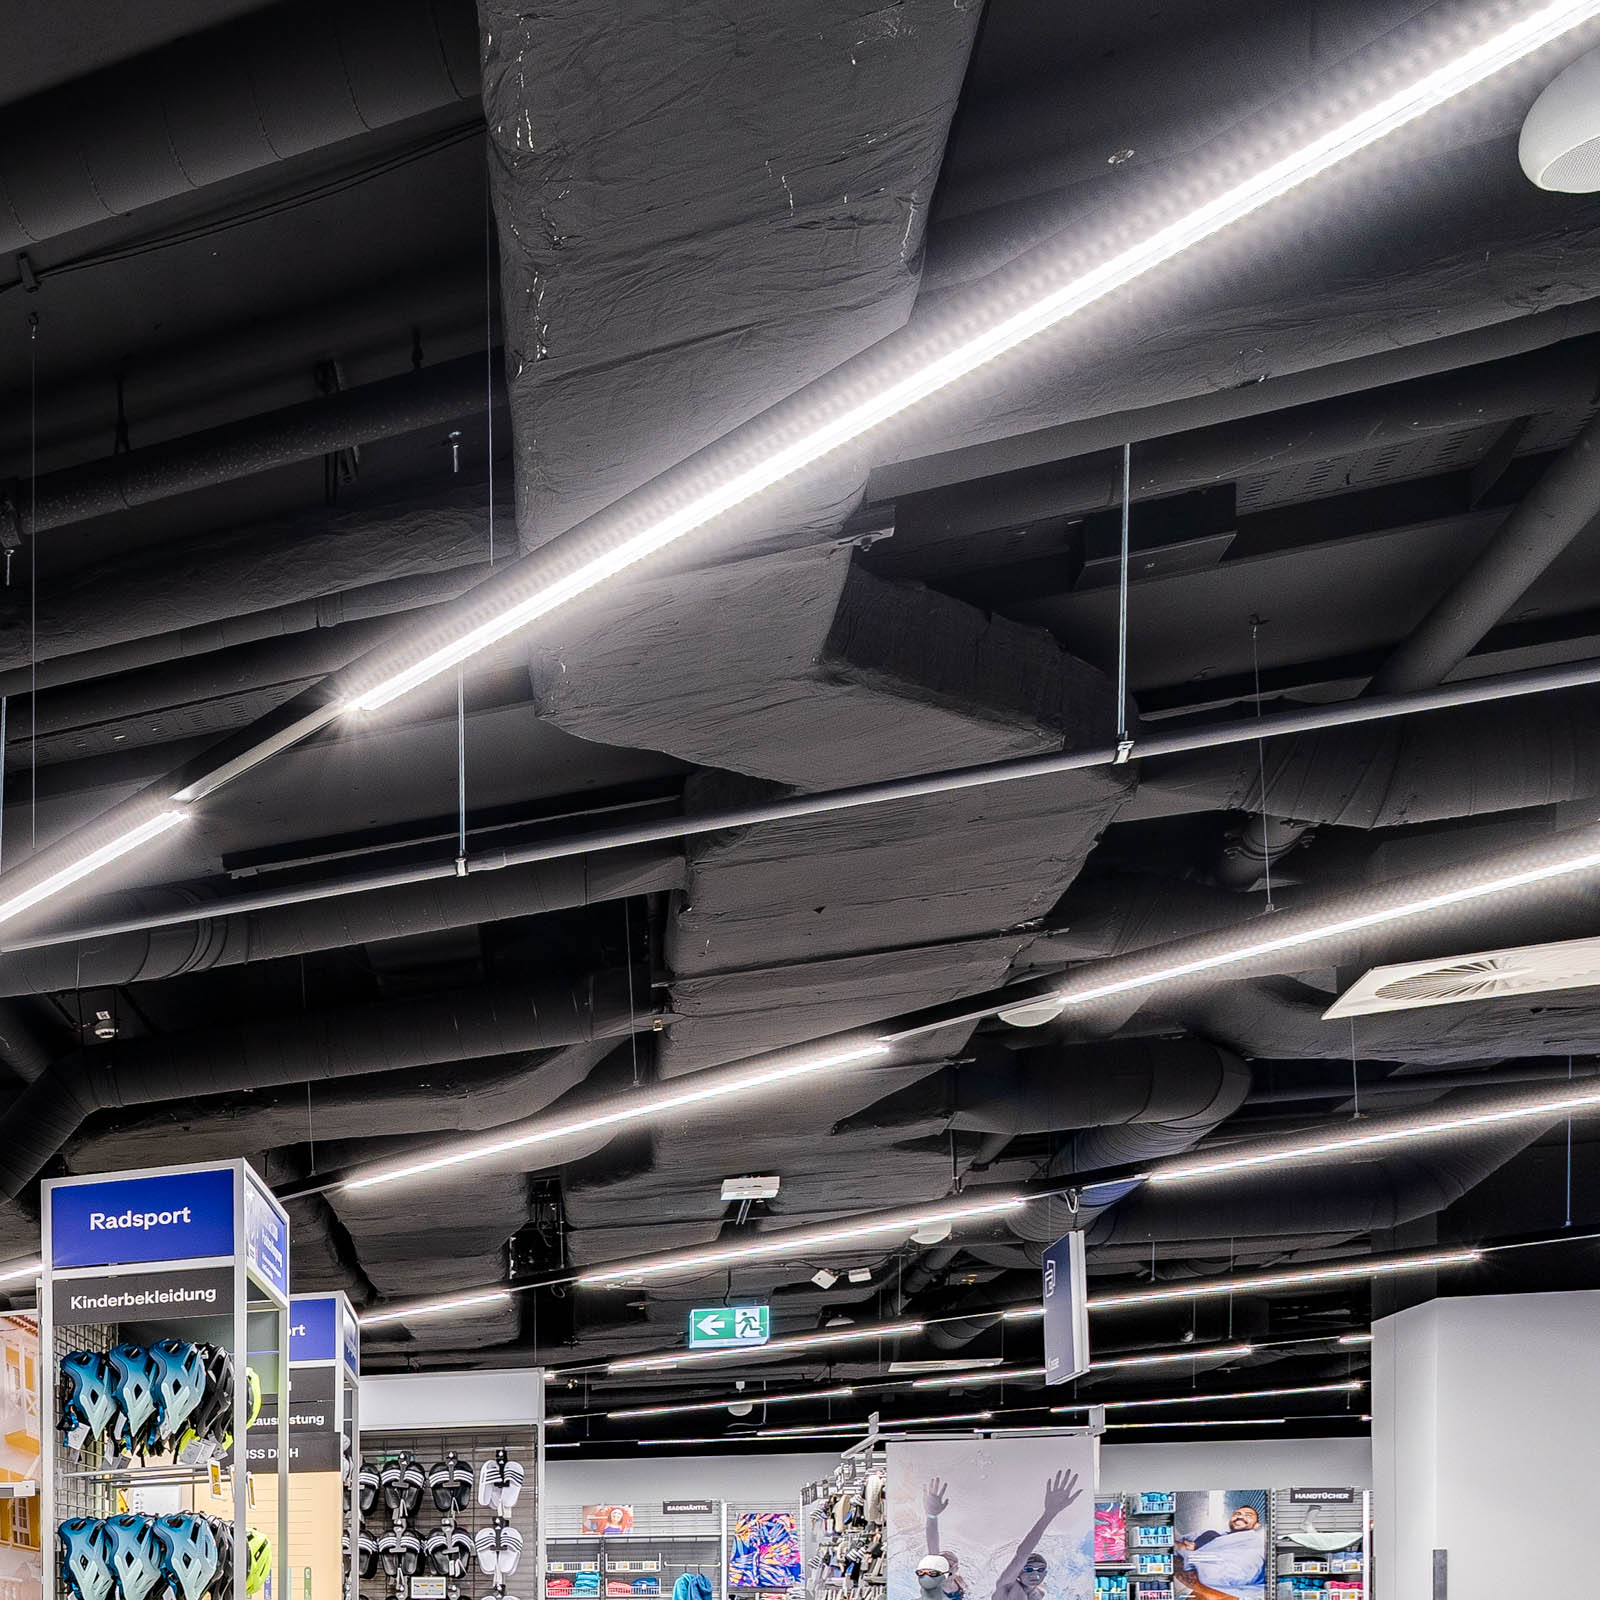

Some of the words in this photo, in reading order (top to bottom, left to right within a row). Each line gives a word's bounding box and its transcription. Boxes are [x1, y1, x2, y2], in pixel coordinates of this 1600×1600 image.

[90, 1206, 191, 1232] Radsport
[70, 1284, 217, 1311] Kinderbekleidung
[1294, 1491, 1350, 1500] HANDTÜCHER
